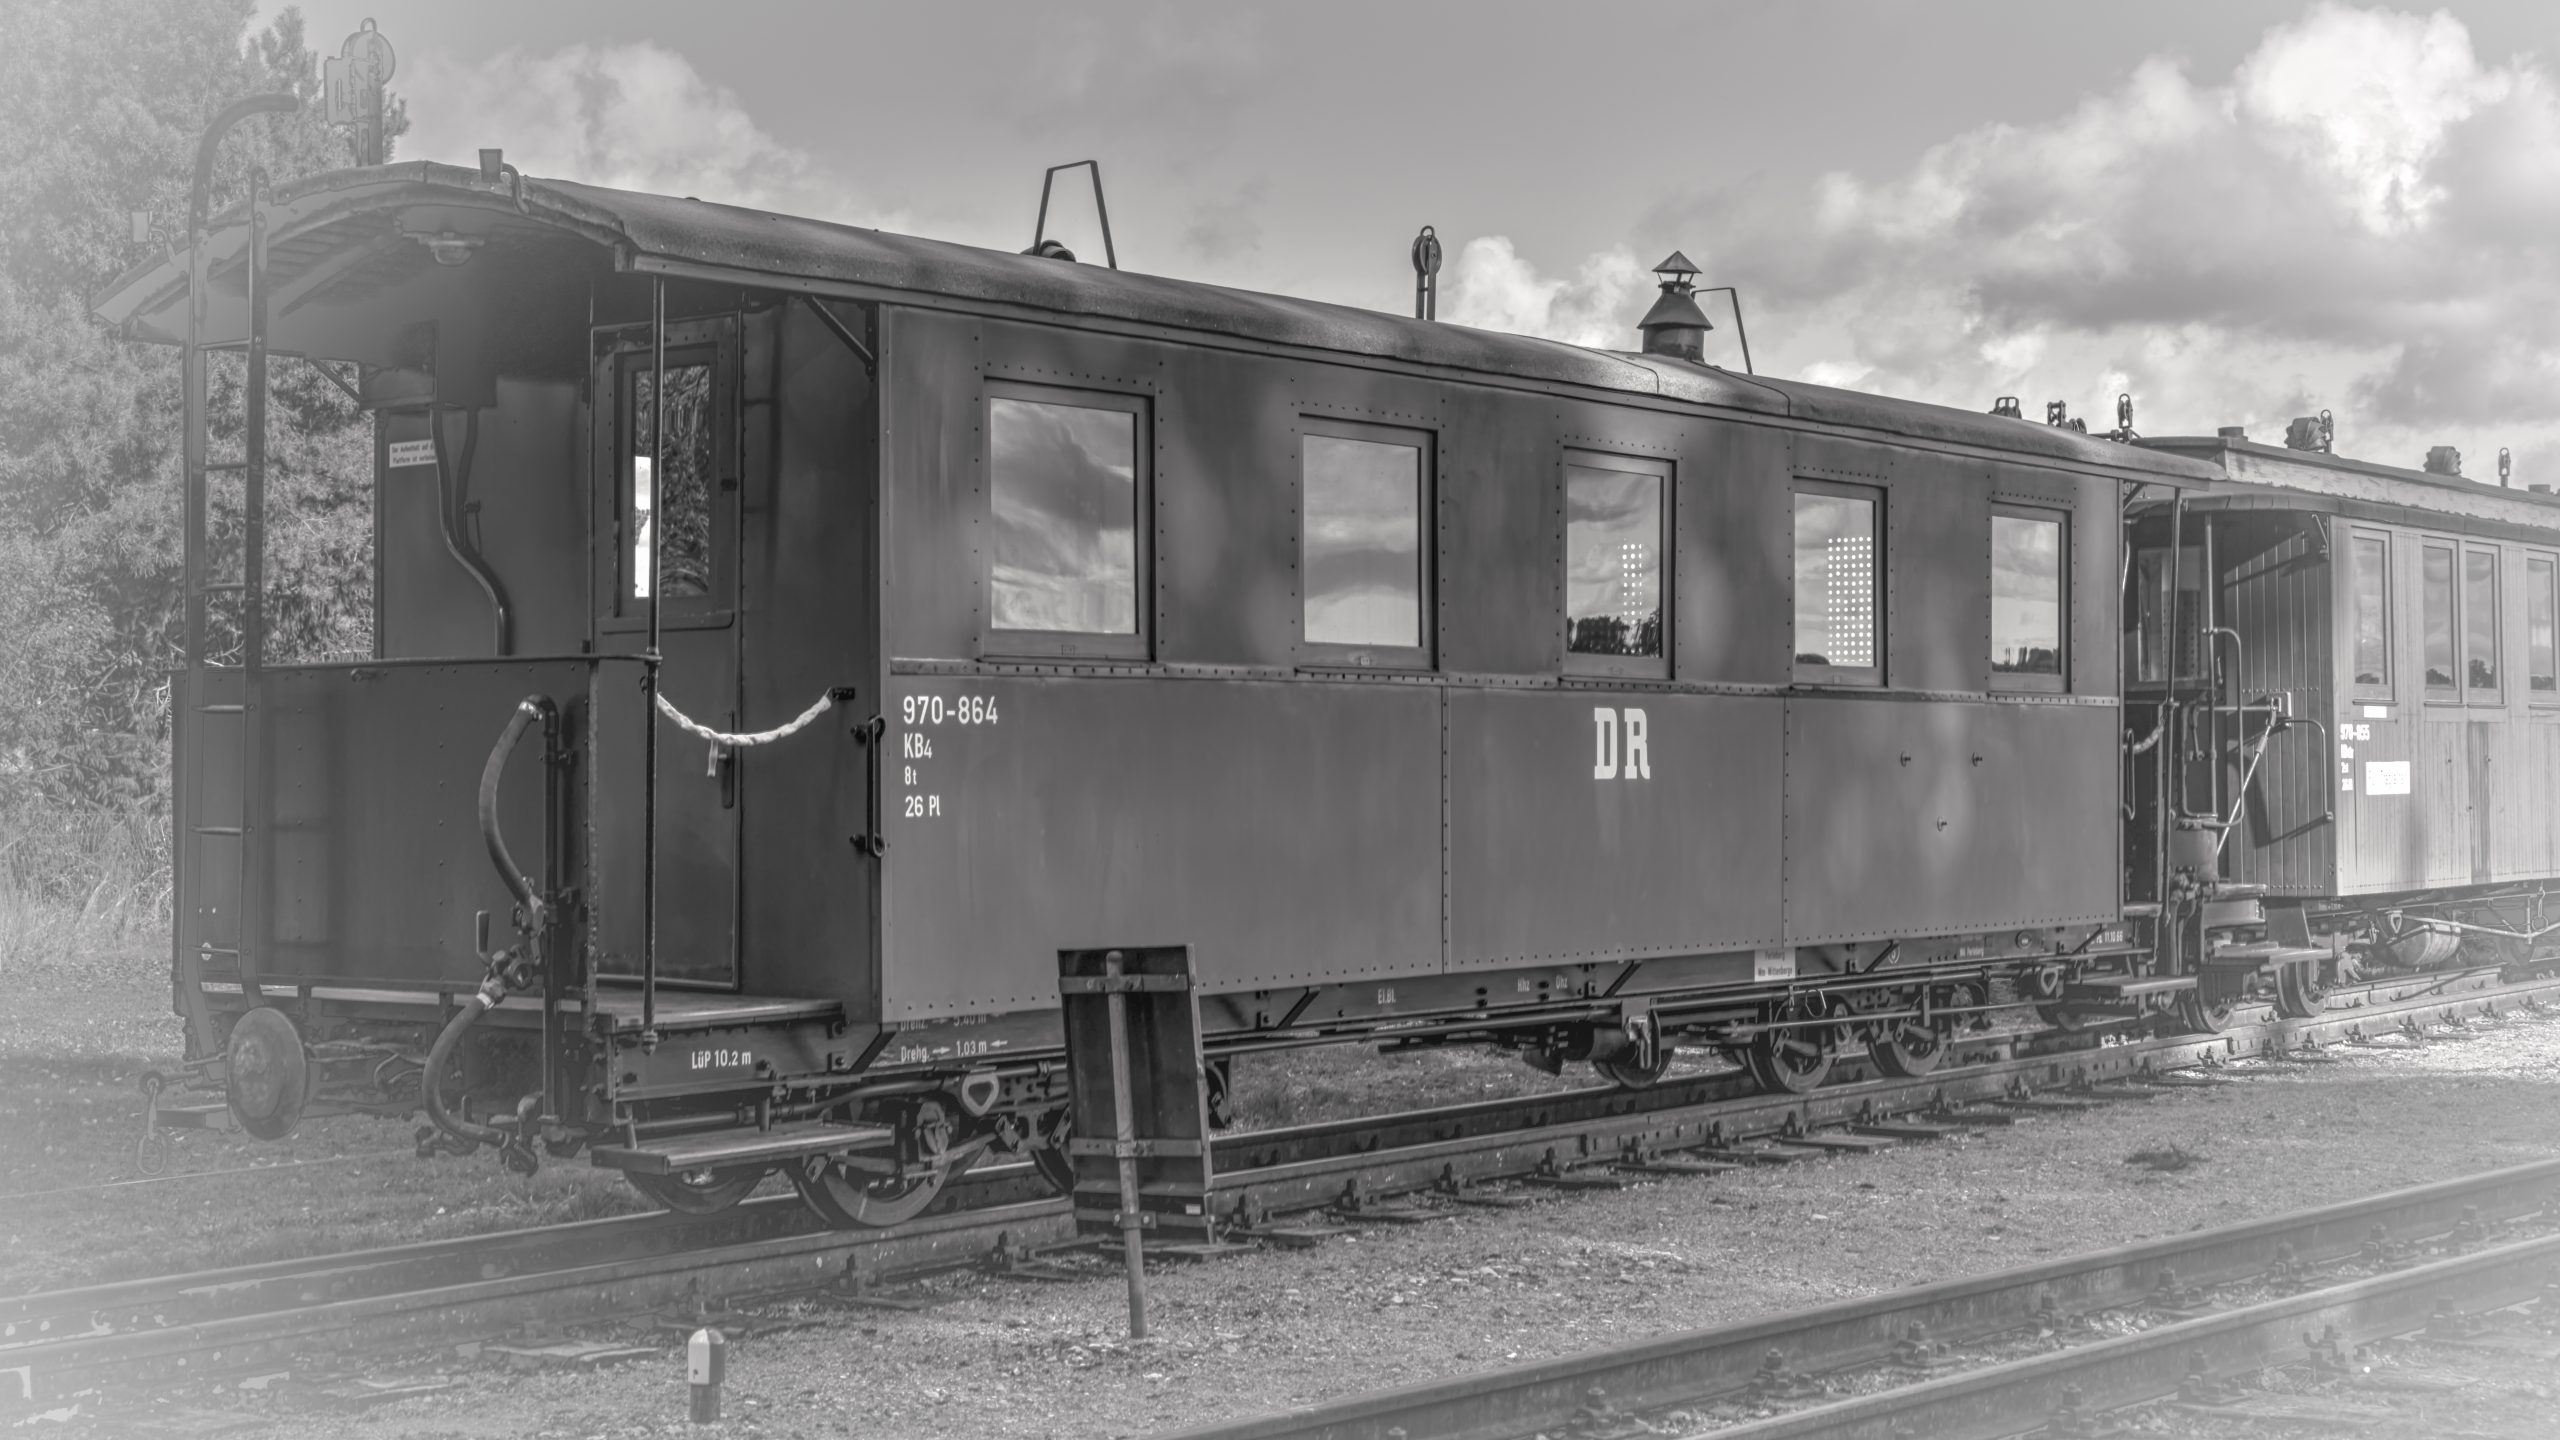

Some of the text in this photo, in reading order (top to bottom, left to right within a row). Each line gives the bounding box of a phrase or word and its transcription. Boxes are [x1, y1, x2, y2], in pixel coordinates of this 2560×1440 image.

[903, 695, 998, 725] 970-864
[904, 733, 933, 759] KB4
[1594, 707, 1651, 780] DR
[905, 795, 941, 817] 26 Pl
[691, 1048, 752, 1070] LüP 10.2 m
[900, 1039, 987, 1063] Drehg. 1.03 m
